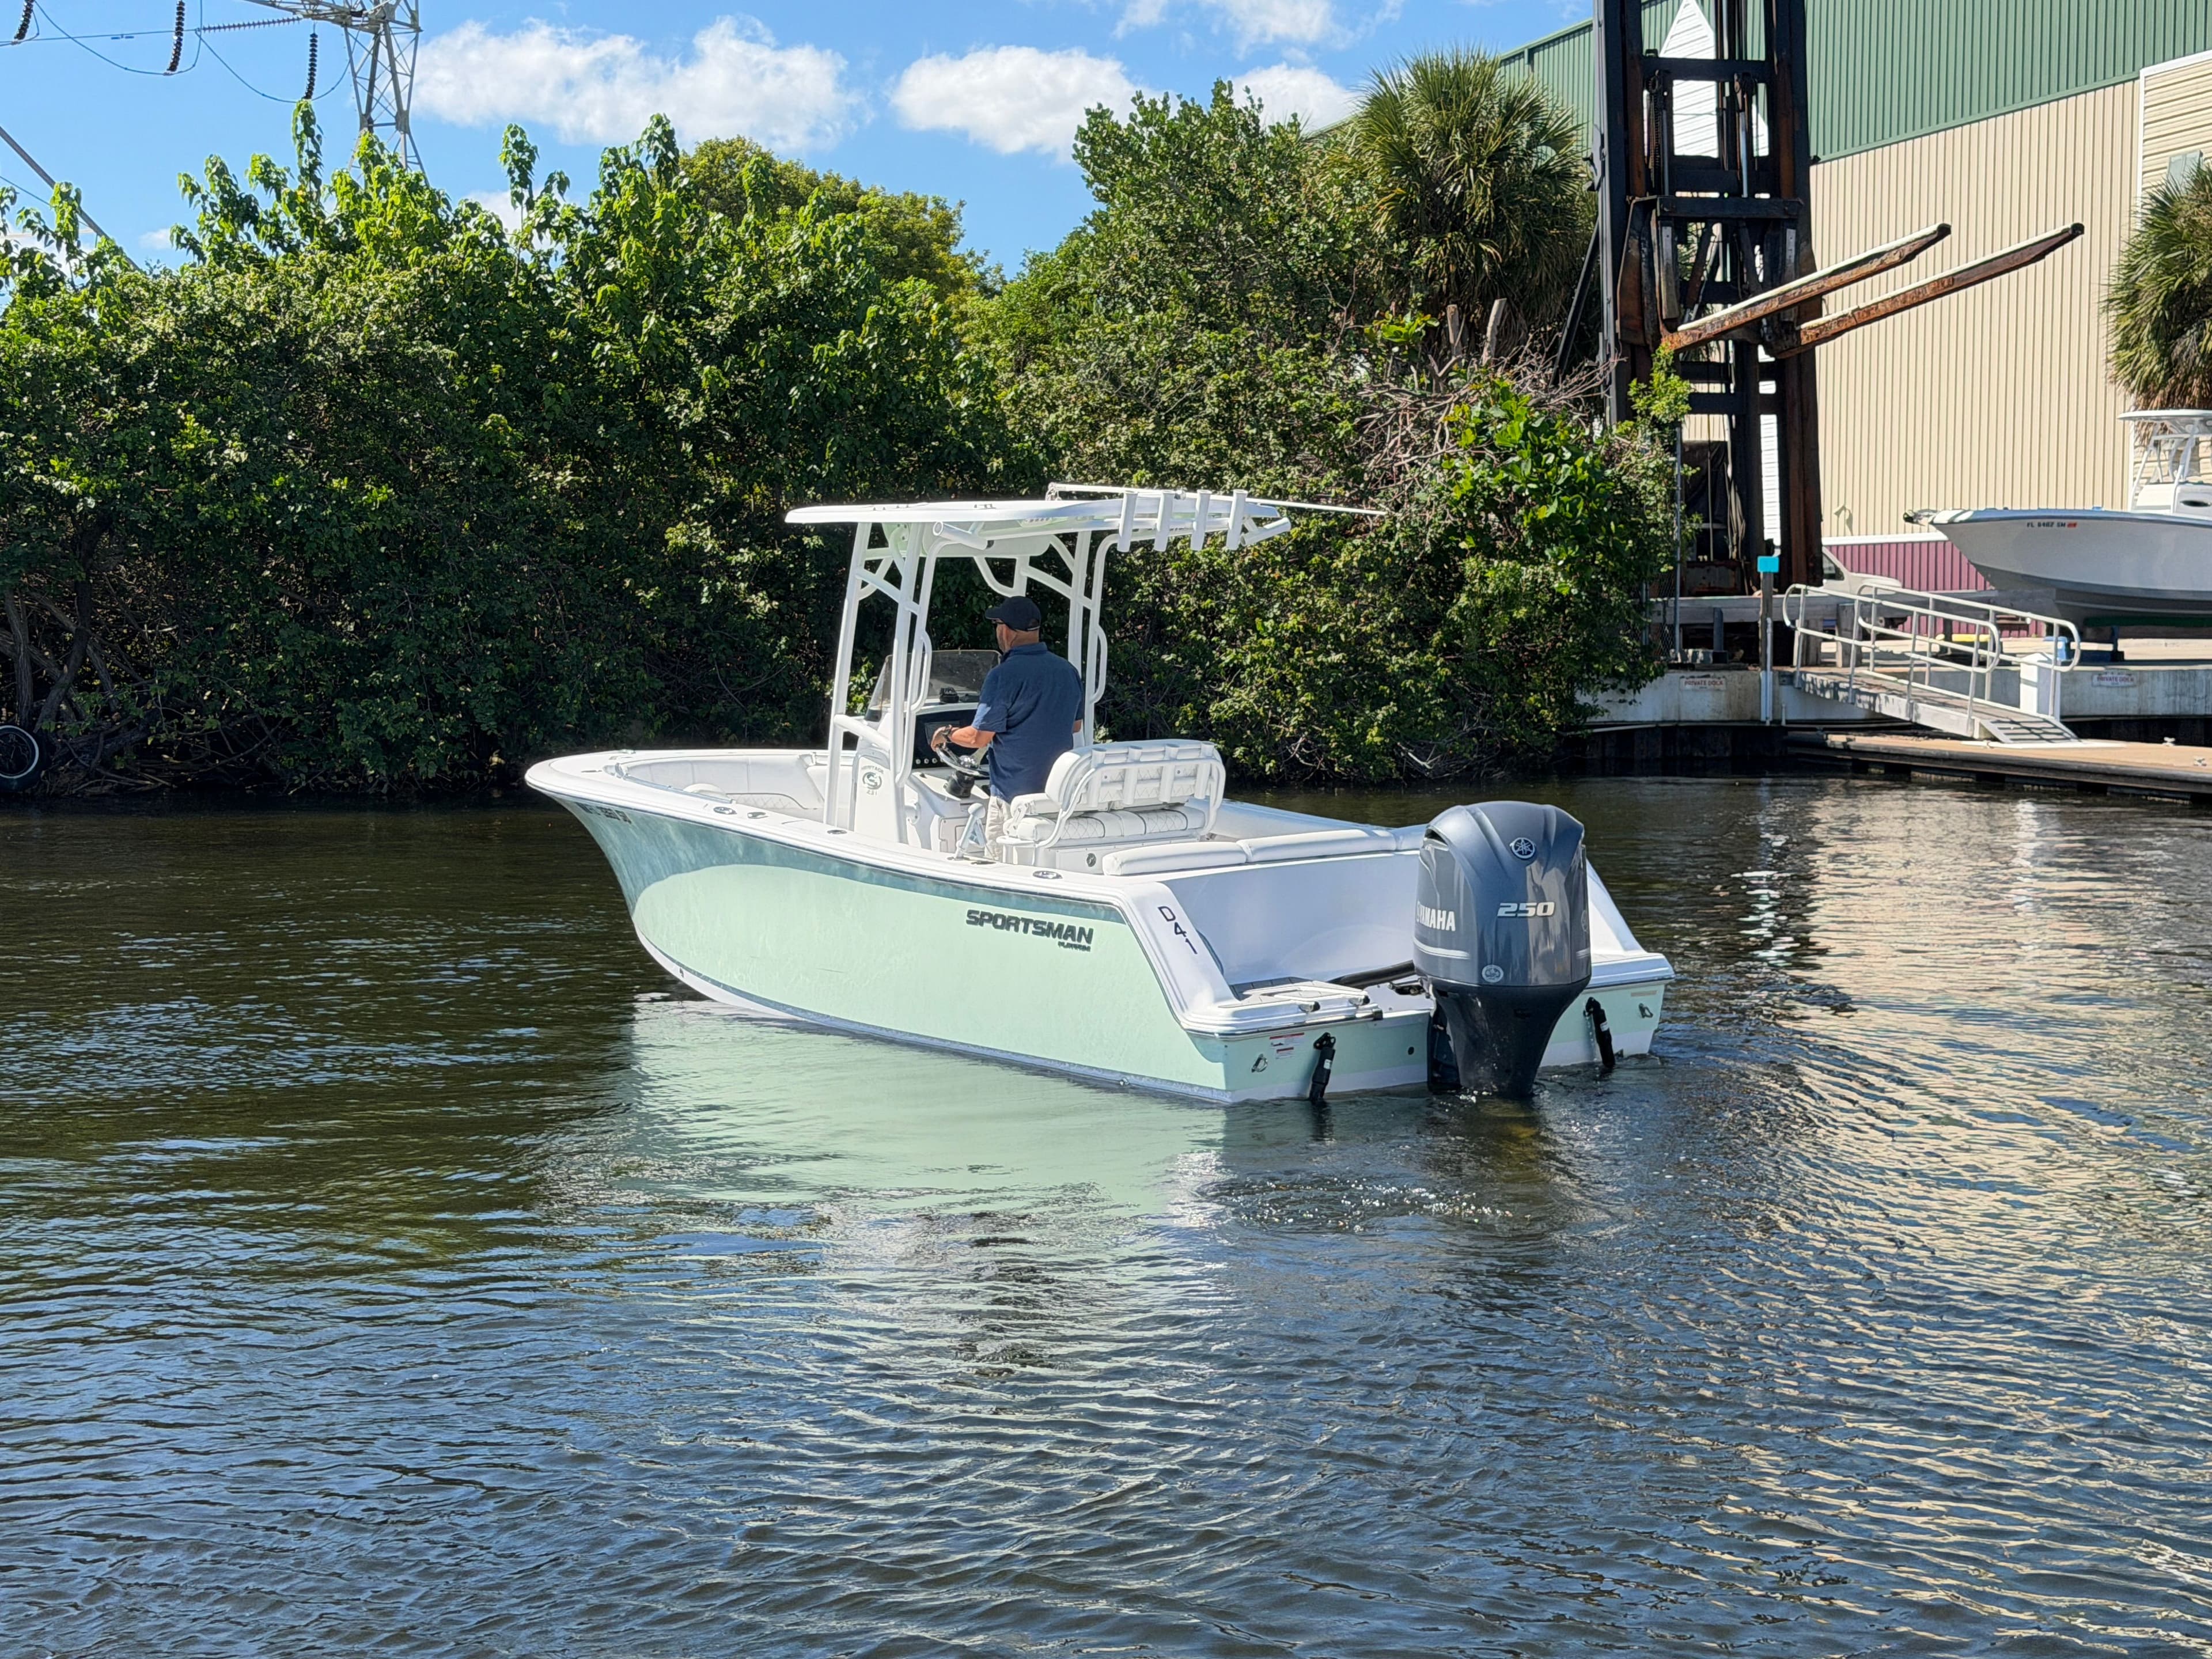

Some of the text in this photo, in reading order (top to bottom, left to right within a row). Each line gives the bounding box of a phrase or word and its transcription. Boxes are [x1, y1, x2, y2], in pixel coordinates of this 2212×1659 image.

[1419, 903, 1456, 931] YAMAHA
[1497, 902, 1555, 917] 250
[966, 909, 1094, 944] SPORTSMAN
